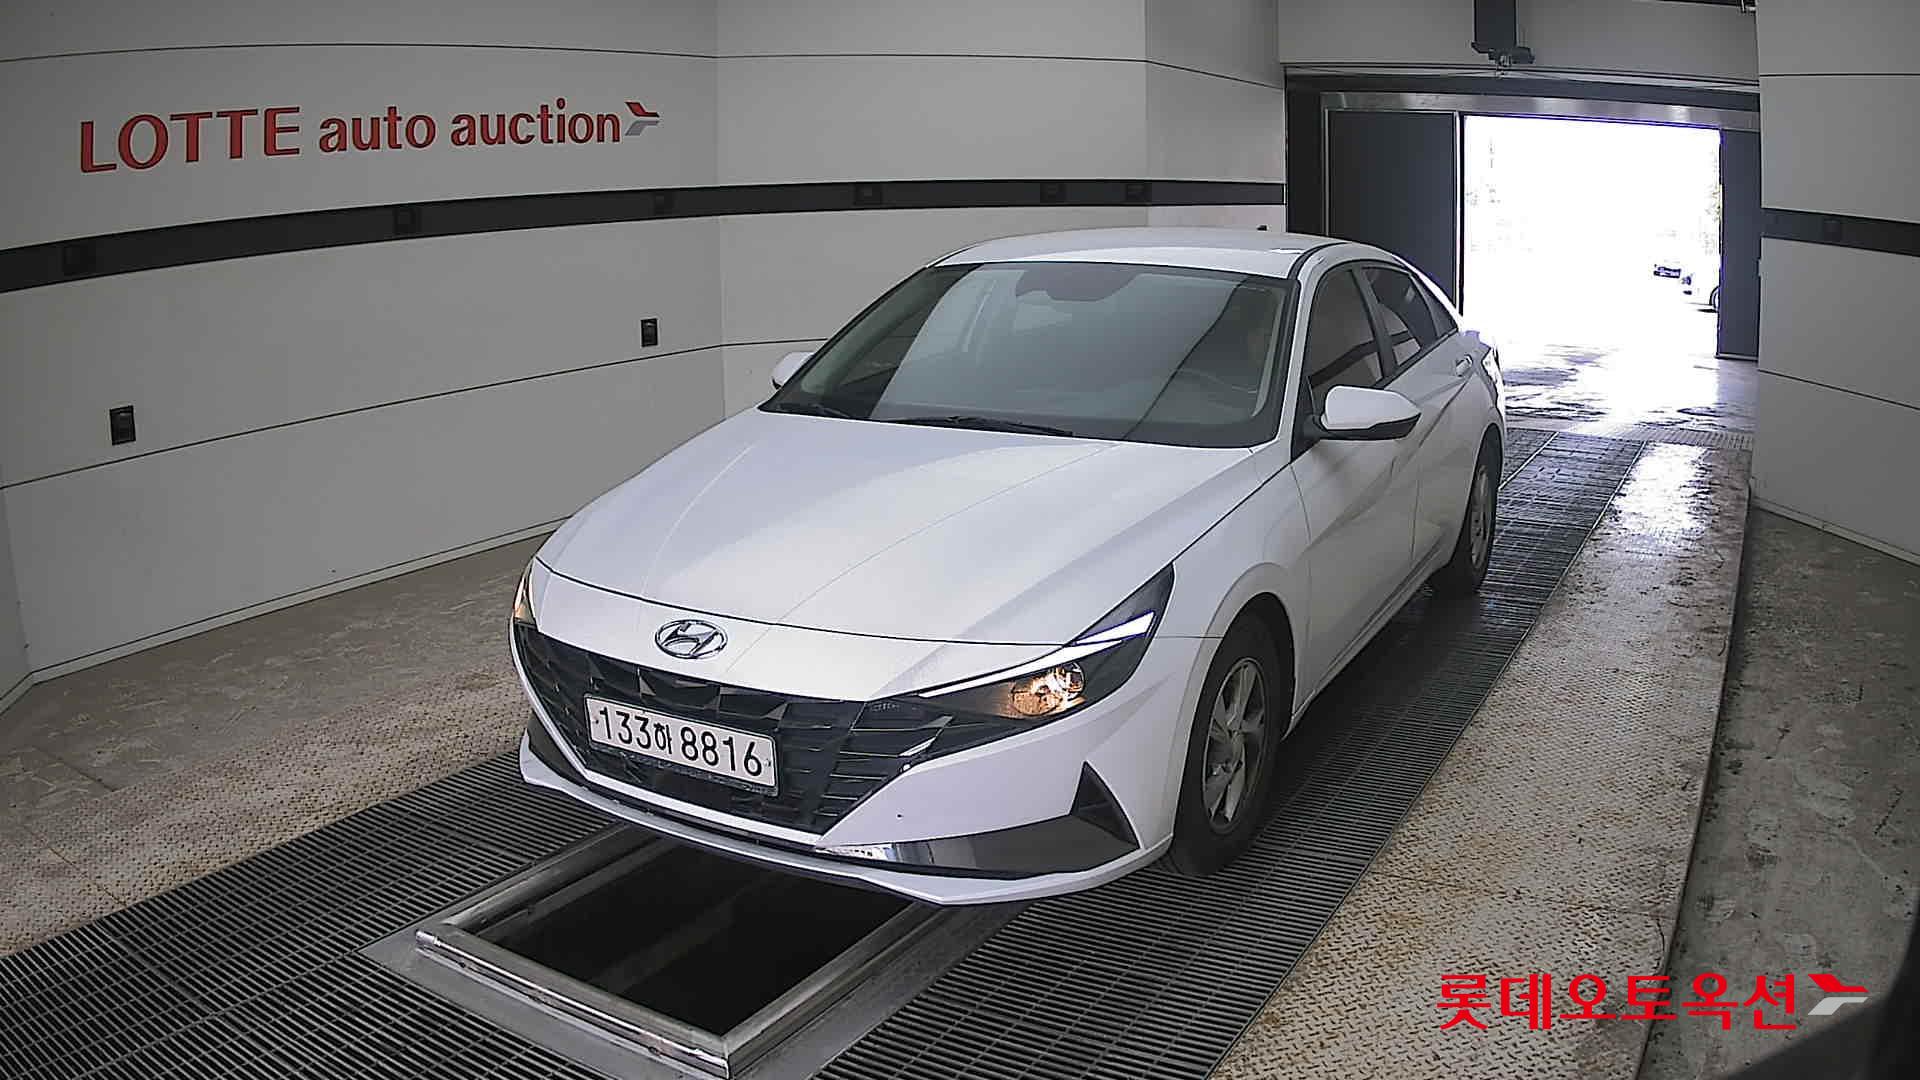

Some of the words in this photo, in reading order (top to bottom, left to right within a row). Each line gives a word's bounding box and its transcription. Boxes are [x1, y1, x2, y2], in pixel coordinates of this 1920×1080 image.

[80, 106, 300, 173] LOTTE
[318, 105, 436, 152] auto
[450, 98, 622, 146] auction
[599, 706, 673, 755] 133하
[680, 726, 762, 777] 8816
